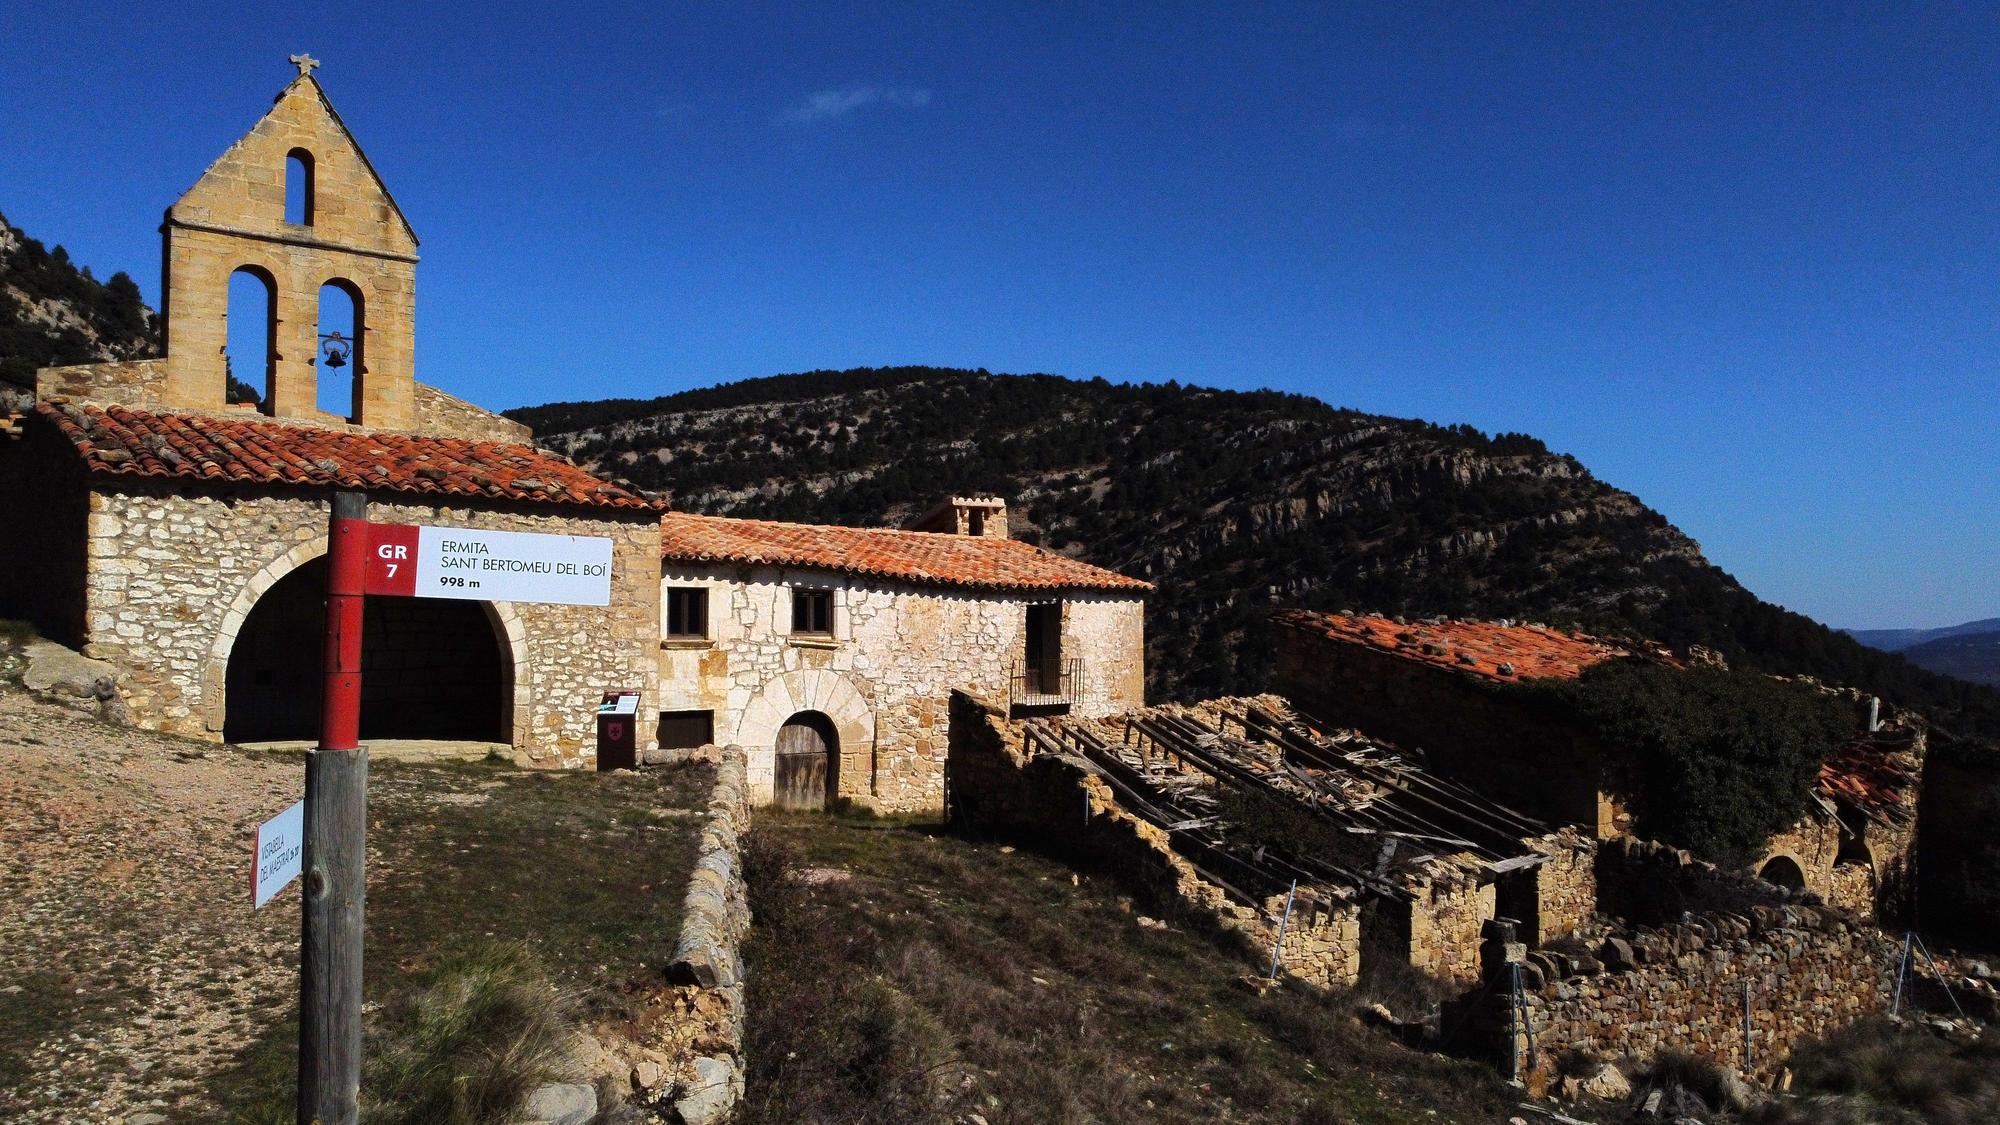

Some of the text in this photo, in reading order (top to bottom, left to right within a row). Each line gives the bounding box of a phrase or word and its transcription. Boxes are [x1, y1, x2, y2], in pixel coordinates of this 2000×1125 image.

[378, 544, 408, 560] GR
[441, 540, 489, 555] ERMITA
[386, 563, 398, 578] 7
[440, 556, 607, 577] SANT BERTOMEU DEL BOÍ
[440, 576, 481, 588] 998 m
